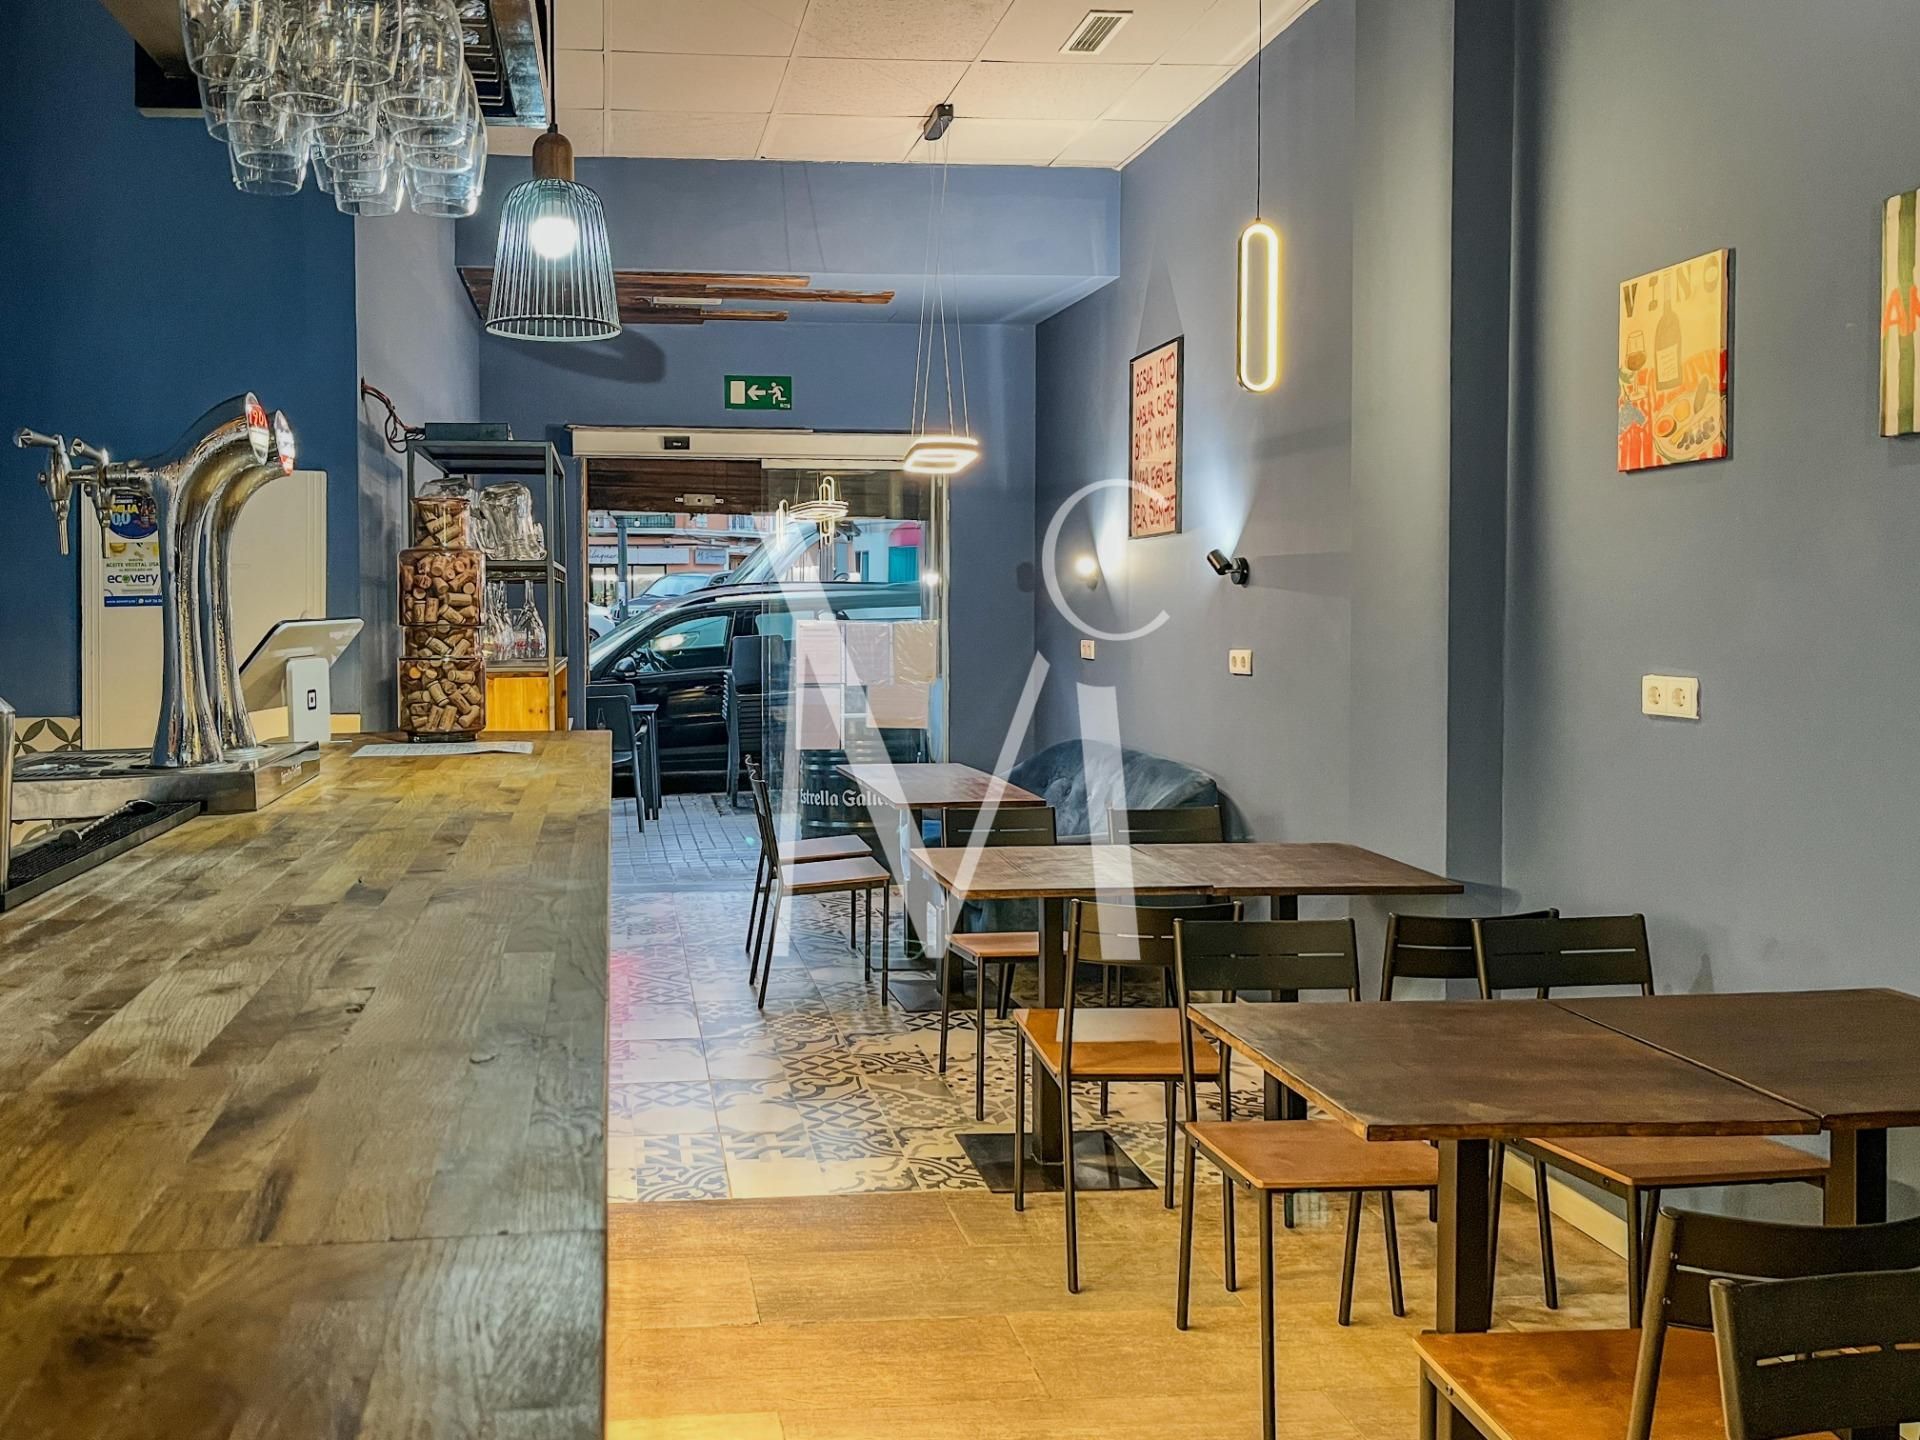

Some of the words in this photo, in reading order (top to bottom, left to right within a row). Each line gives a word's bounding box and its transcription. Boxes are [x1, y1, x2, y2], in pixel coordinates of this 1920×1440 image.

[1623, 255, 1720, 318] VINO
[1156, 352, 1175, 388] LENTO
[107, 573, 159, 586] ecovery
